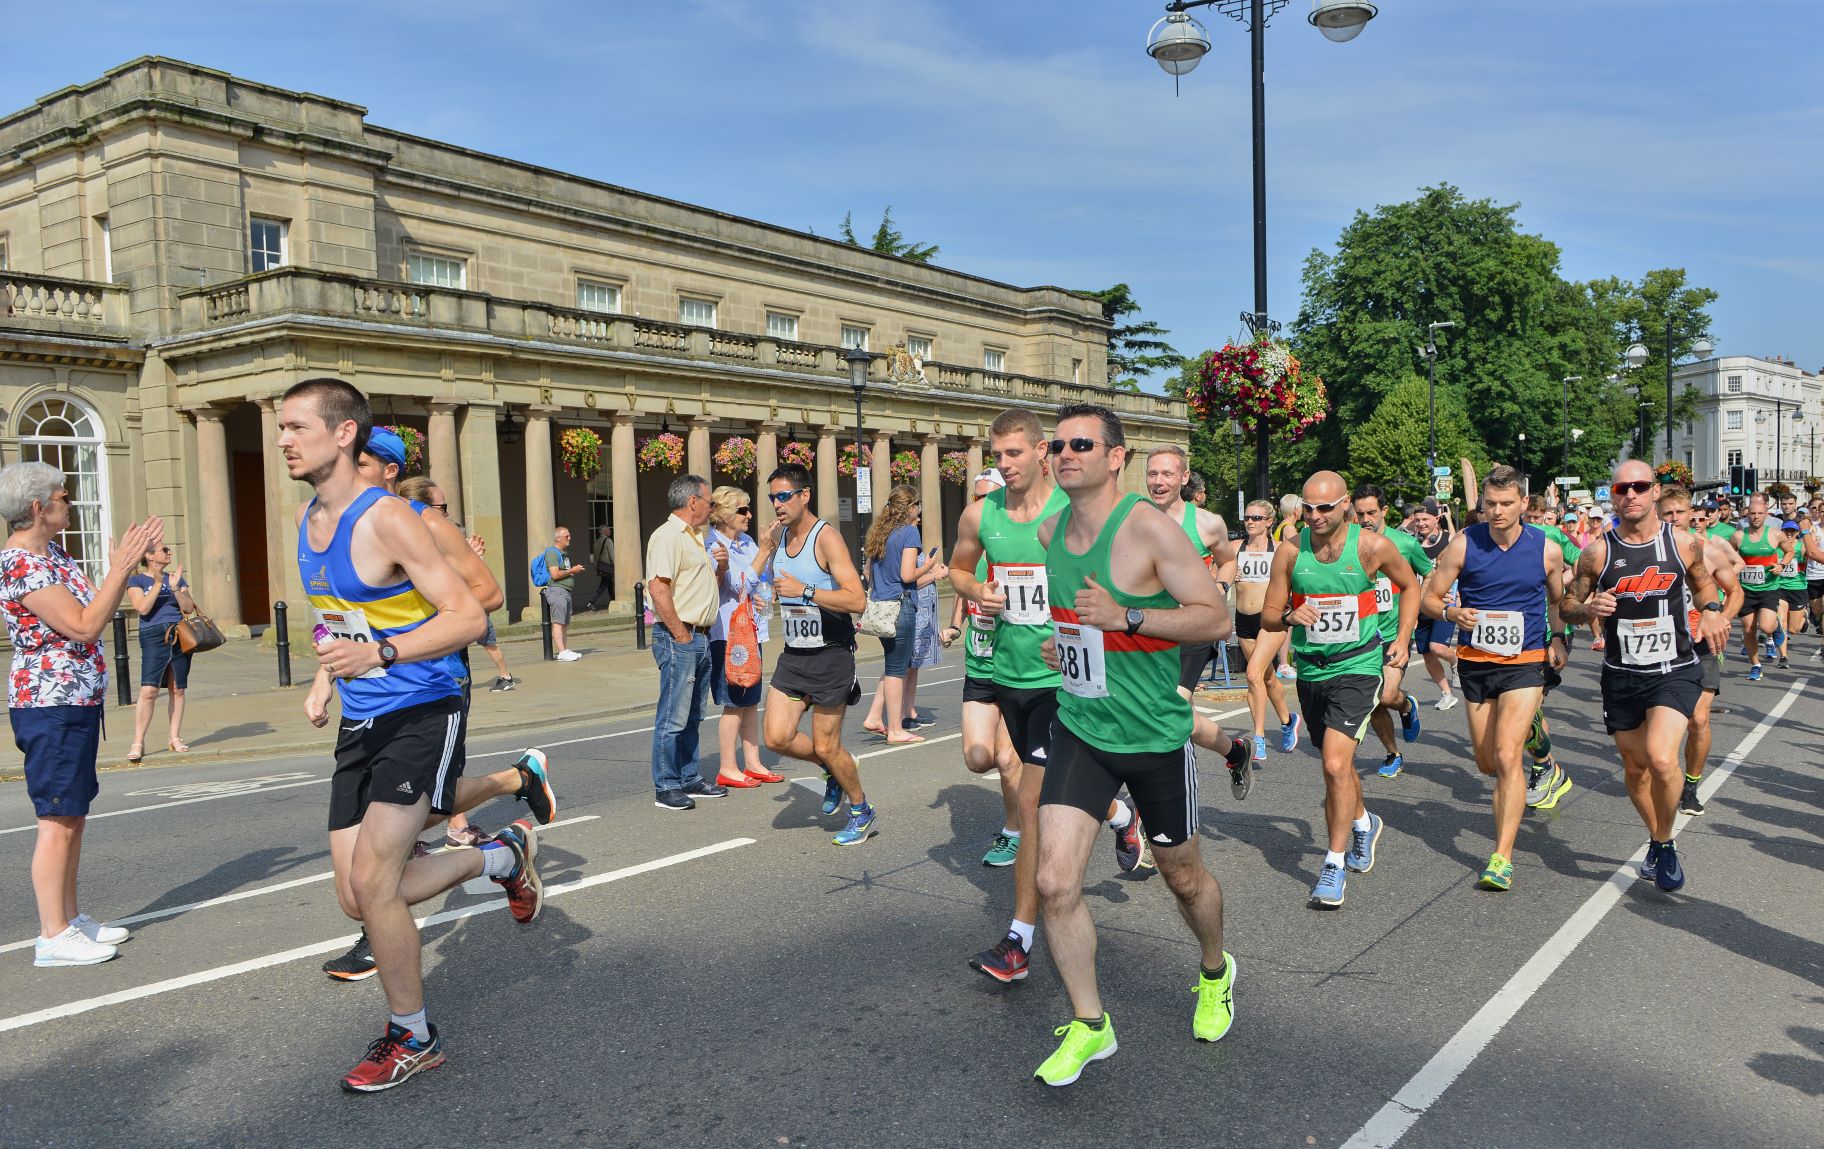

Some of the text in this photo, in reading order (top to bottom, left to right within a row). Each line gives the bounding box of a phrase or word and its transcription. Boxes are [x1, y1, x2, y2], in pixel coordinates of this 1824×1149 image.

[540, 385, 712, 416] ROYAL
[770, 406, 867, 426] PUMP
[1242, 560, 1269, 576] 610
[1742, 571, 1764, 580] 1770
[1003, 585, 1046, 611] 114
[785, 619, 819, 637] 1180
[1477, 624, 1521, 646] 1838
[1623, 631, 1672, 654] 1729
[1057, 643, 1092, 682] 881
